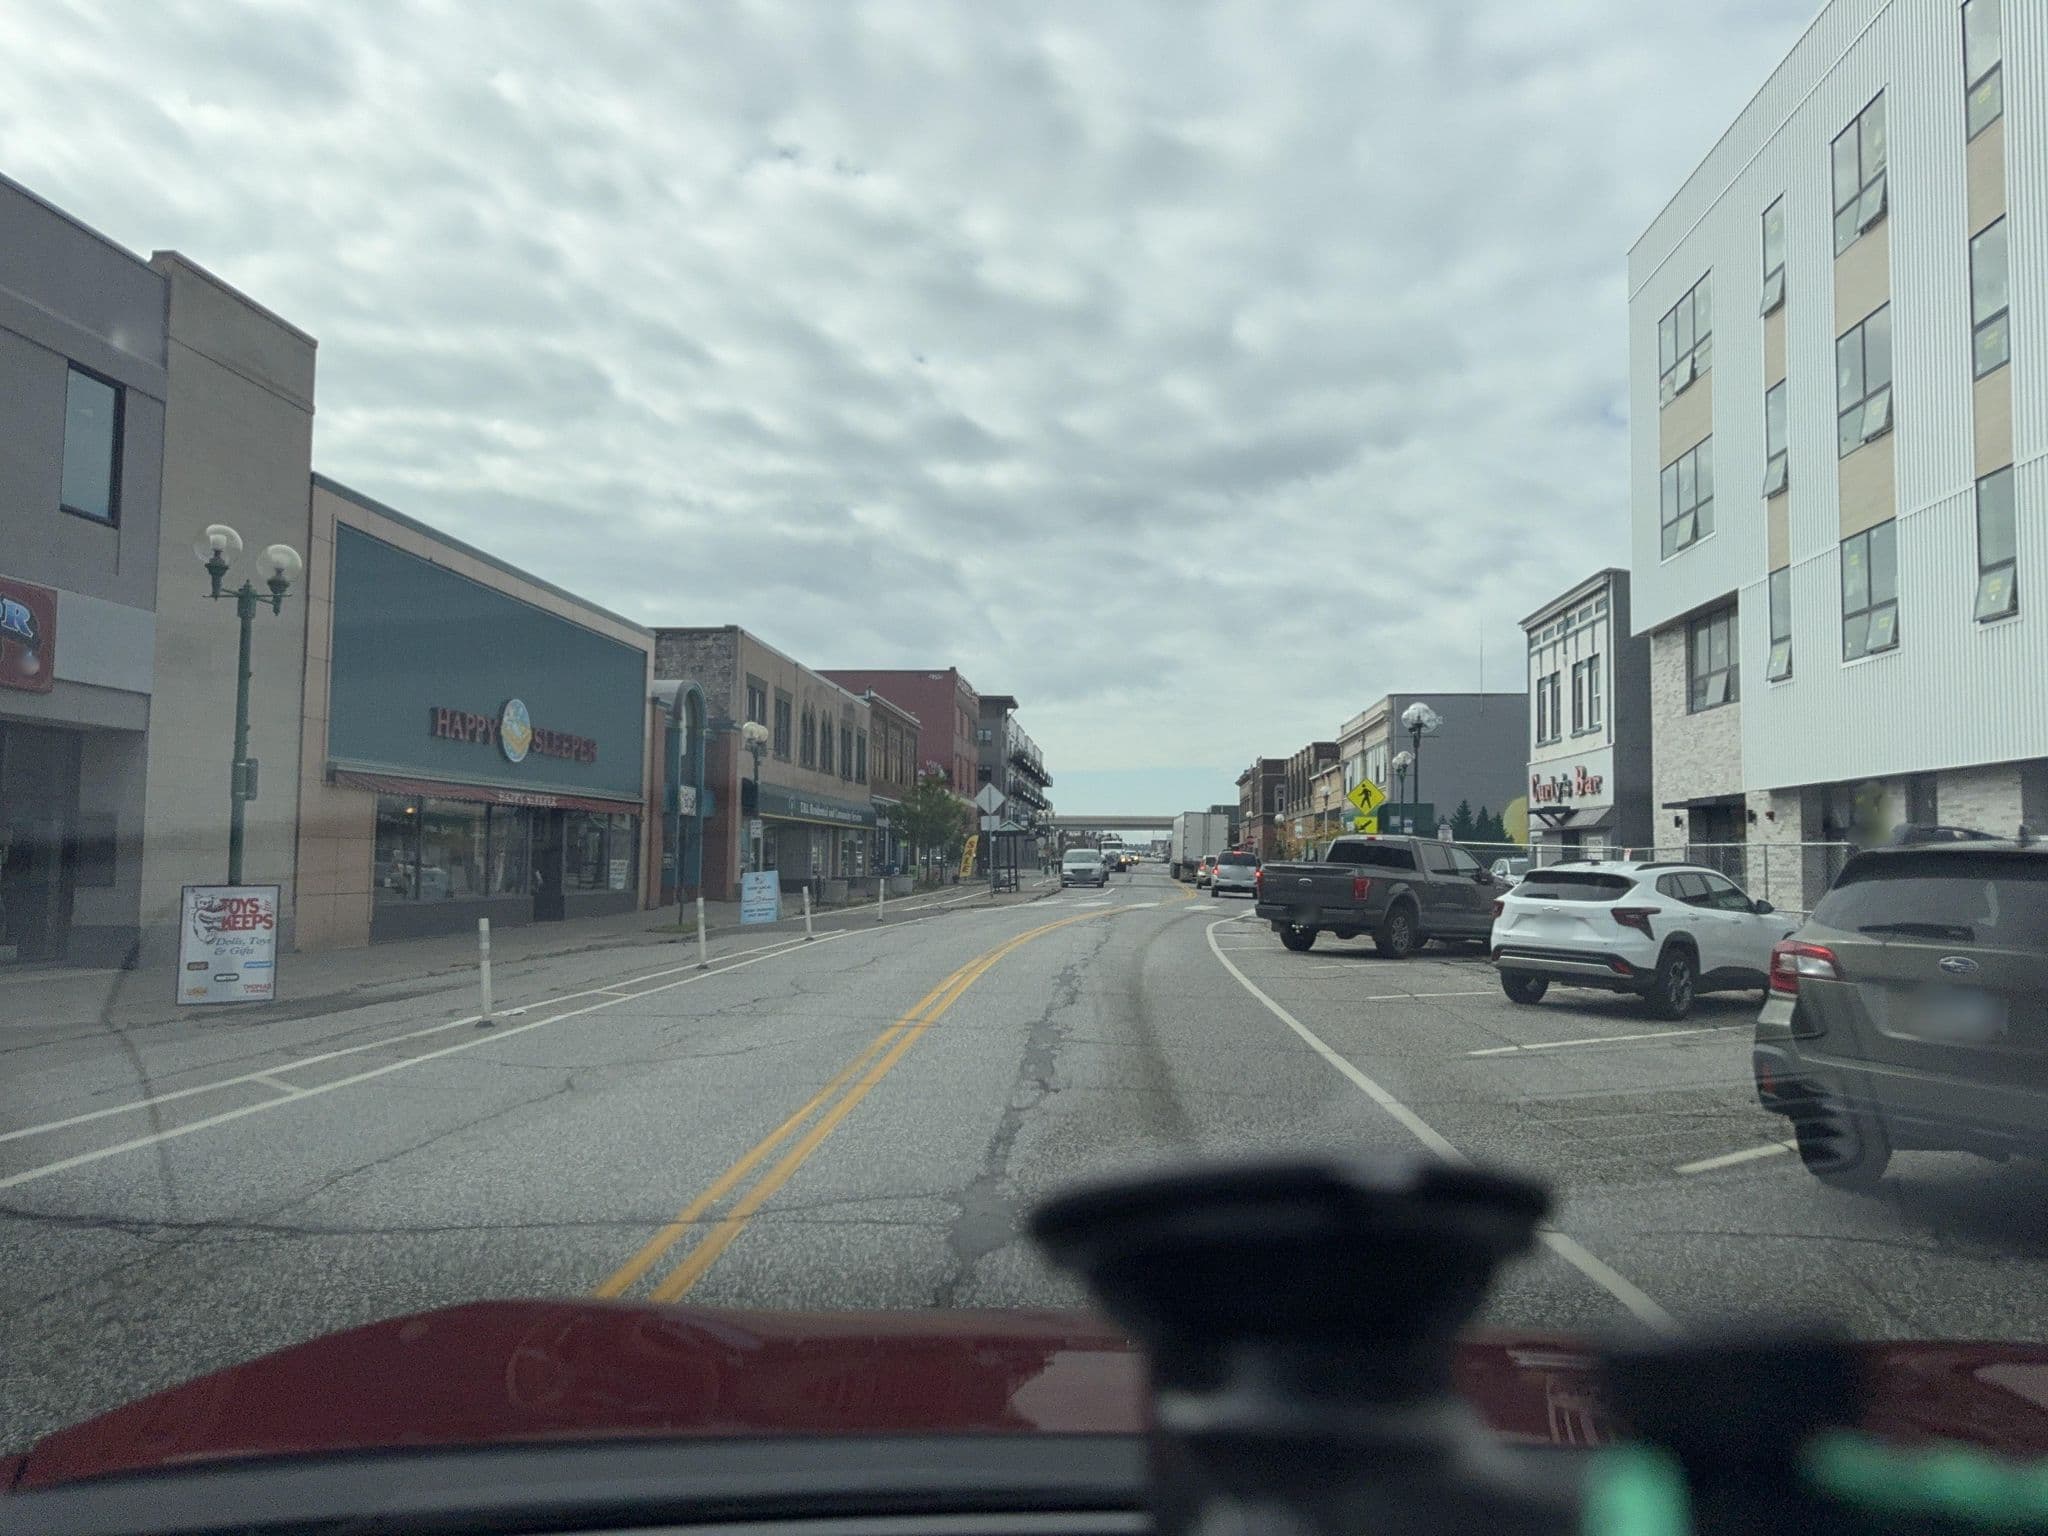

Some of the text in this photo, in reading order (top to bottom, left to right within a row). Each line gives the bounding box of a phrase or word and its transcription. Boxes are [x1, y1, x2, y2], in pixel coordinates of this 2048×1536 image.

[0, 597, 33, 638] R
[435, 708, 498, 744] HAPPY
[1532, 766, 1603, 803] Curly's Bar
[962, 840, 976, 873] SALE
[220, 898, 259, 914] TOYS
[221, 914, 273, 931] KEEPS
